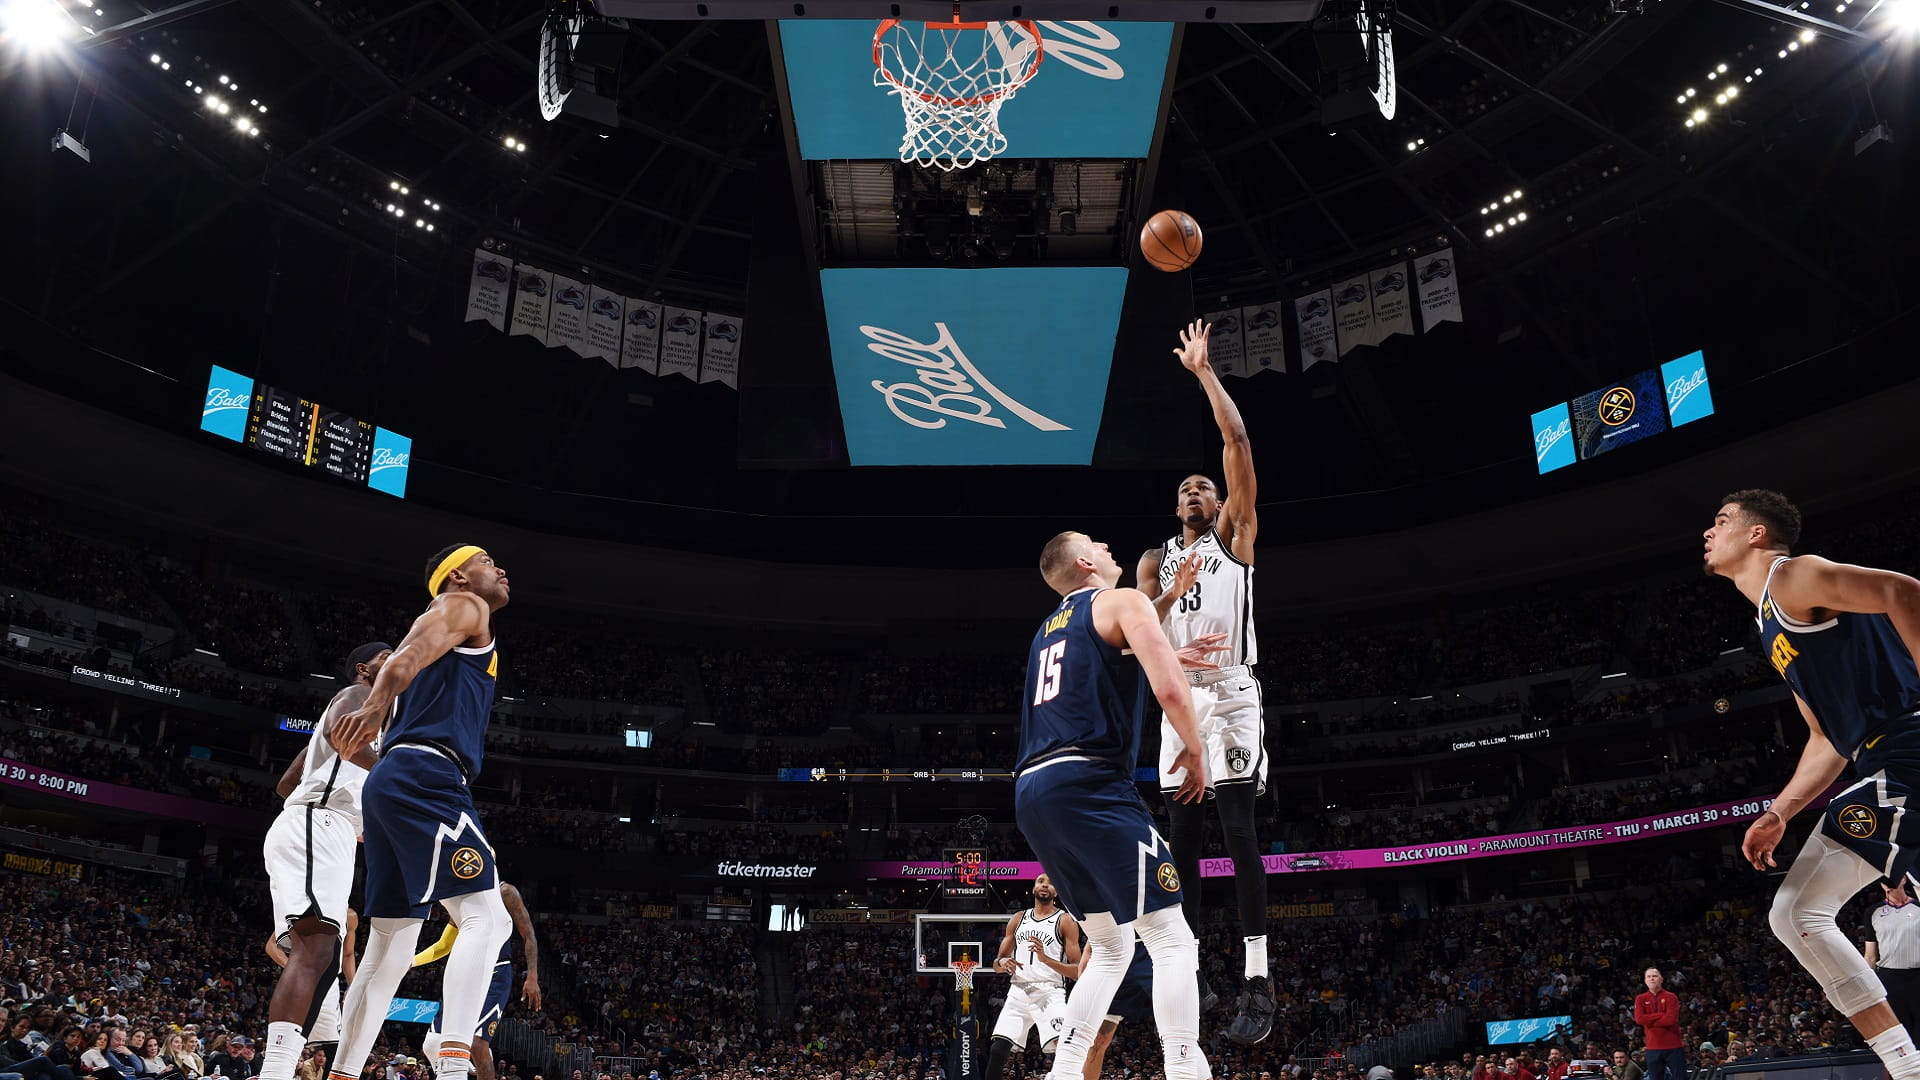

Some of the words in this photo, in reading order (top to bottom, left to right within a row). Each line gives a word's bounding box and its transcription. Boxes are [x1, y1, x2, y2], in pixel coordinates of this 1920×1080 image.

[514, 318, 546, 330] CHAMPIONS
[859, 322, 1073, 431] Ball
[1667, 367, 1708, 415] Ball
[203, 388, 250, 415] Ball
[272, 400, 290, 412] O'Neale
[270, 410, 288, 422] Bridges
[260, 428, 292, 444] Finney-Smith
[1536, 418, 1572, 463] Ball
[370, 448, 408, 473] Ball
[1180, 581, 1201, 614] 33
[72, 666, 100, 678] [CROWD
[104, 673, 134, 686] YELLING
[1034, 639, 1067, 706] 15
[286, 718, 312, 730] HAPPY
[1478, 736, 1506, 746] YELLING
[1227, 748, 1250, 760] NETS
[10, 766, 26, 780] 30
[38, 774, 64, 790] 8:00
[66, 780, 88, 796] PM
[1384, 849, 1424, 862] BLACK
[1426, 844, 1468, 858] VIOLIN
[1480, 834, 1550, 852] PARAMOUNT
[1553, 828, 1602, 844] THEATRE
[1614, 824, 1640, 837] THU
[1652, 812, 1700, 831] MARCH
[1703, 810, 1718, 822] 30
[1732, 802, 1760, 817] 8:00
[1763, 798, 1777, 812] P
[956, 852, 980, 864] 5:00
[717, 861, 817, 879] ticketmaster
[814, 910, 845, 922] Coors
[413, 1002, 438, 1022] Ball
[1490, 1020, 1511, 1044] Ball
[1518, 1018, 1540, 1043] Ball
[960, 1034, 971, 1076] verizon
